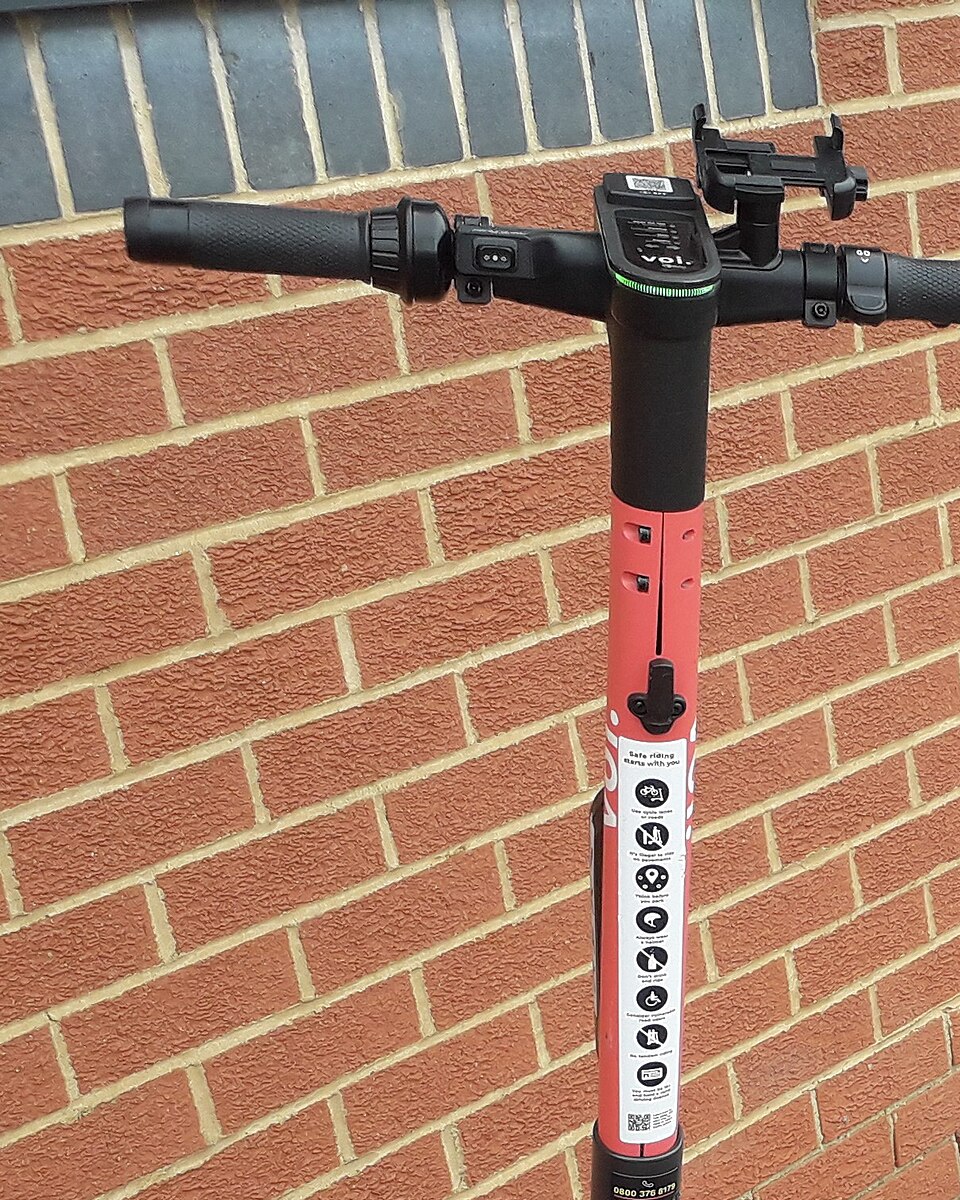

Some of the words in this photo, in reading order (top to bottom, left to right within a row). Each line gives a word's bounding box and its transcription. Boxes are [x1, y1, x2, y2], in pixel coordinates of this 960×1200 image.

[641, 255, 692, 265] voi.
[629, 750, 647, 759] Safe
[650, 752, 675, 760] riding
[647, 759, 665, 767] with
[666, 760, 681, 768] you
[613, 1186, 637, 1197] 0800
[639, 1189, 656, 1198] 376
